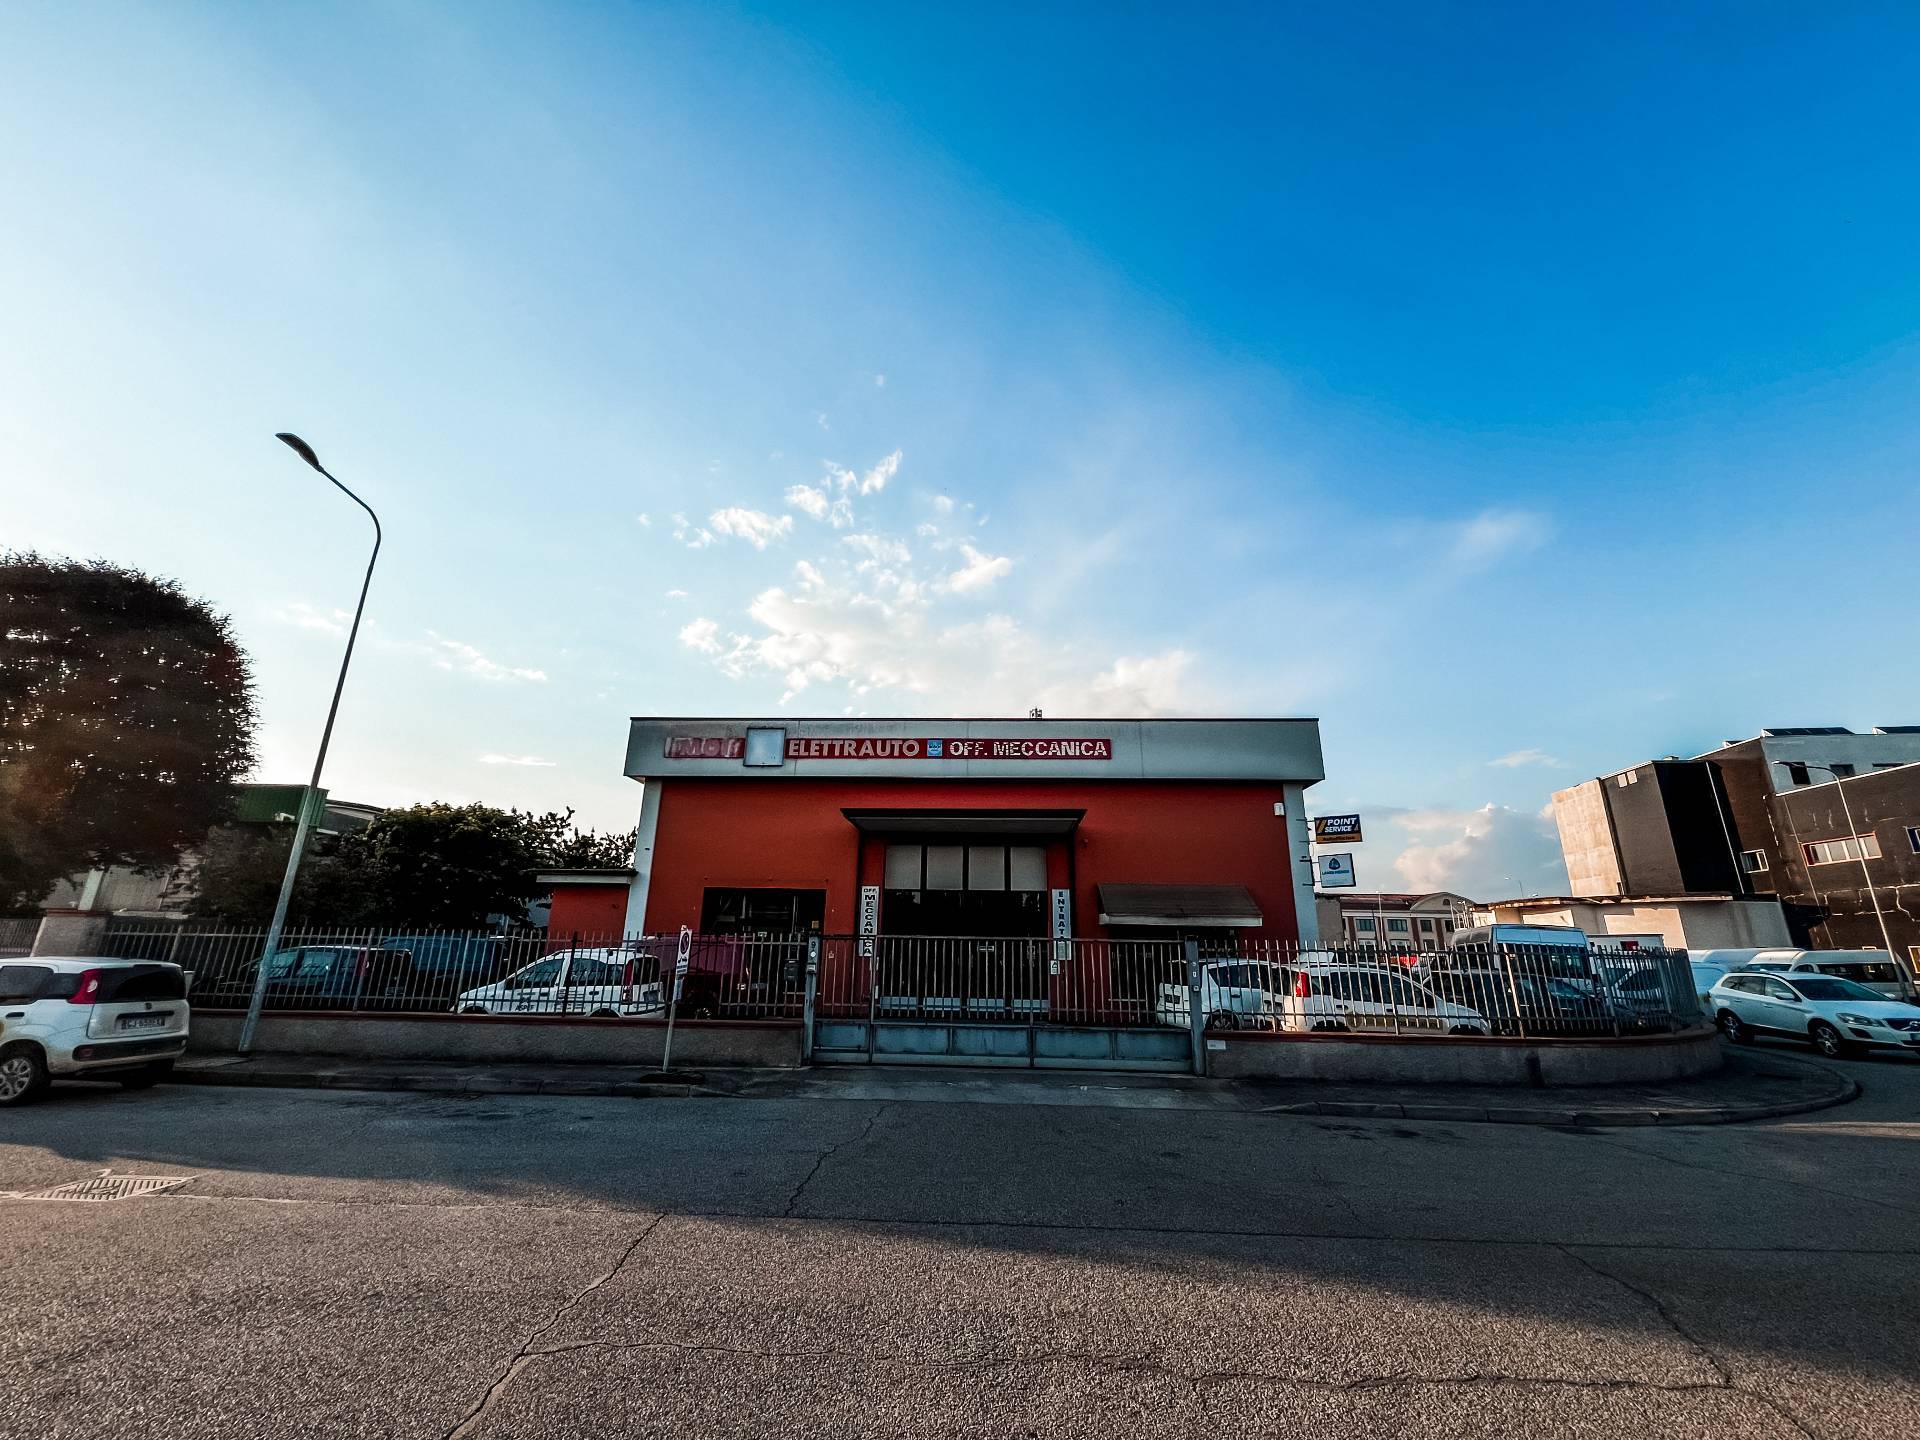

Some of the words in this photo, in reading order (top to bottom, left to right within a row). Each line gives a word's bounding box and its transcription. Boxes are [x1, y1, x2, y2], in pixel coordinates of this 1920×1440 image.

[788, 739, 920, 757] ELETTRAUTO
[950, 741, 988, 756] OFF.
[993, 741, 1108, 756] MECCANICA
[1327, 818, 1356, 826] POINT
